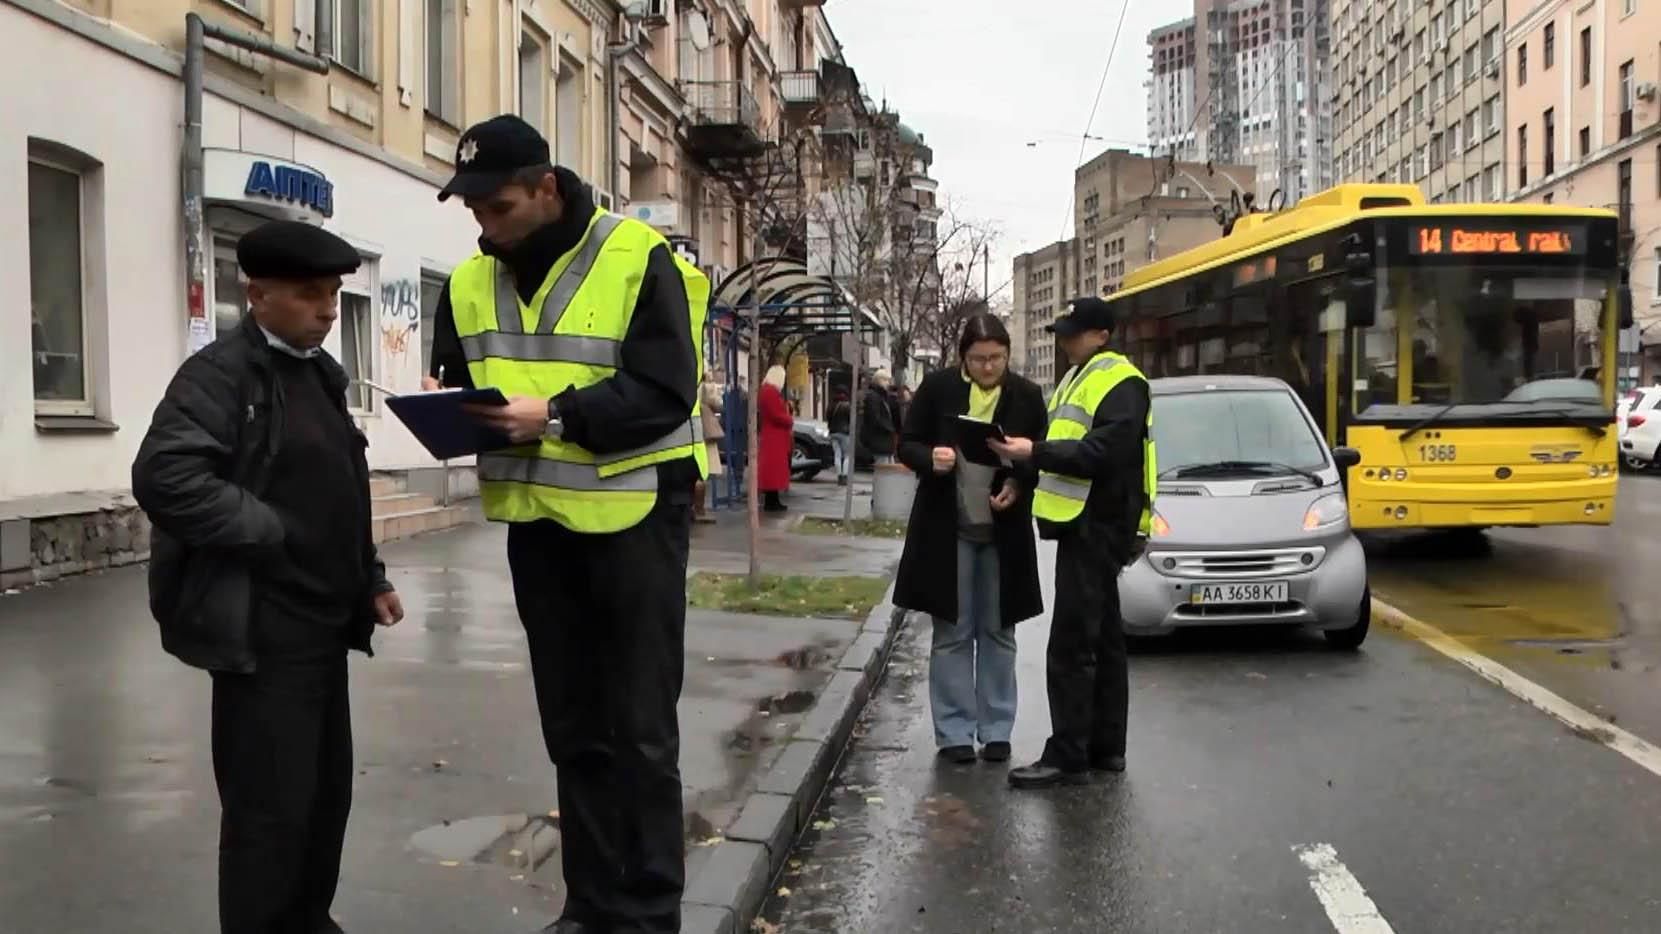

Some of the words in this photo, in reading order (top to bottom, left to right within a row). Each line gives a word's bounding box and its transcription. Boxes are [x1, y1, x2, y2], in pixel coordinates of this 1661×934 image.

[244, 161, 334, 218] АПТЕ
[1420, 228, 1443, 253] 14
[1451, 229, 1522, 253] Central
[1419, 444, 1457, 462] 1368
[1202, 586, 1224, 601] AA
[1227, 584, 1261, 601] 3658
